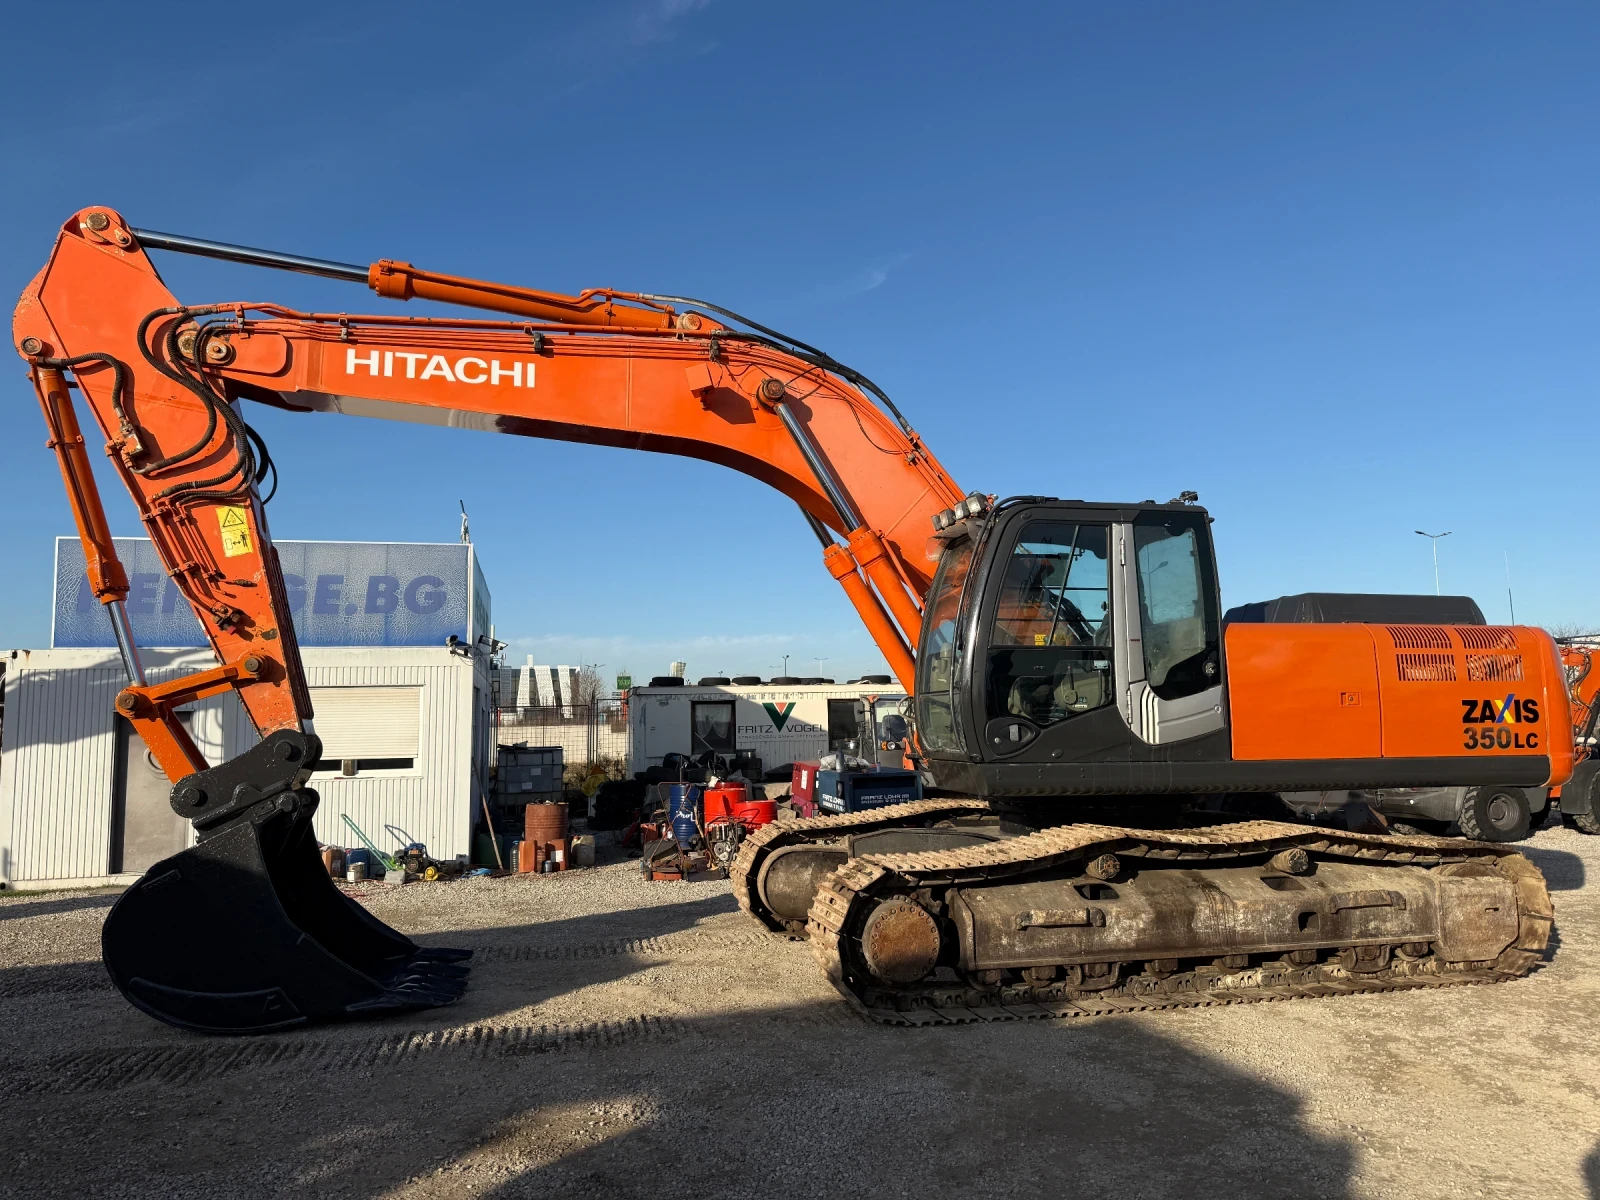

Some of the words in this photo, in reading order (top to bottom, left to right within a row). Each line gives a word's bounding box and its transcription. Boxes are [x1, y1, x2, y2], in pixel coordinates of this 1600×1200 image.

[345, 348, 536, 388] HITACHI
[1461, 693, 1540, 723] ZAXIS
[738, 725, 774, 734] FRITZ
[786, 724, 828, 733] VOGEL
